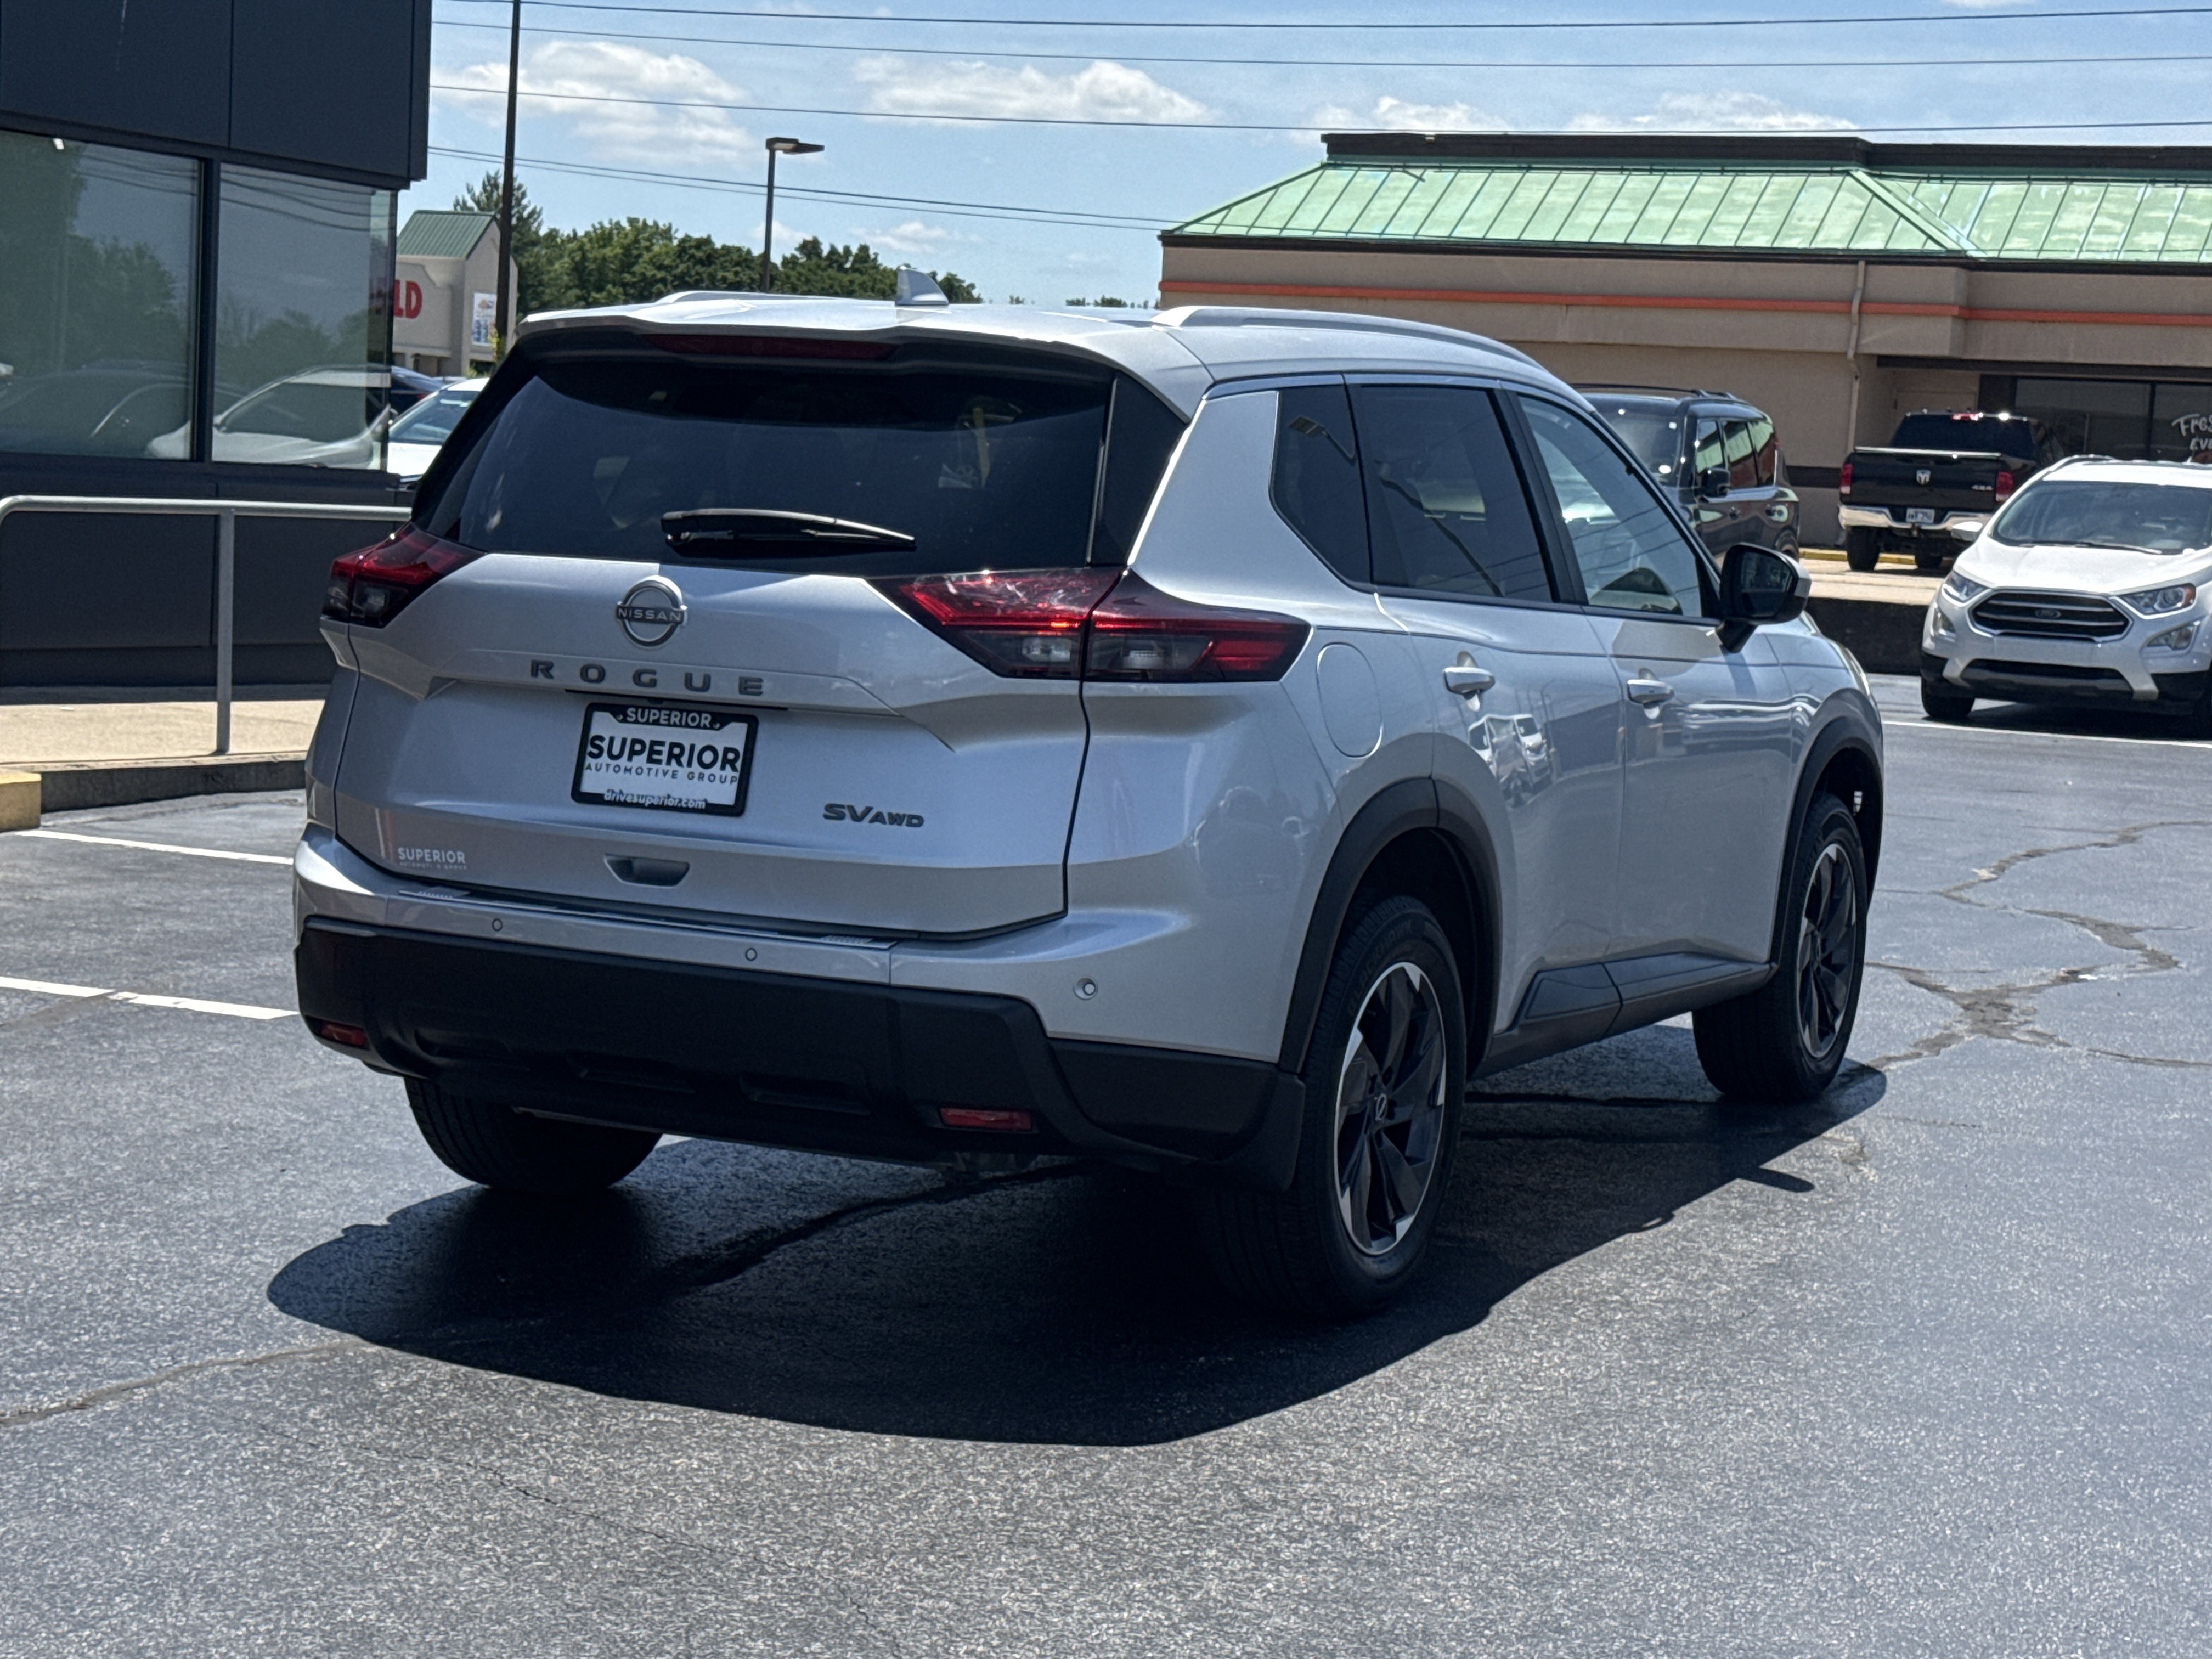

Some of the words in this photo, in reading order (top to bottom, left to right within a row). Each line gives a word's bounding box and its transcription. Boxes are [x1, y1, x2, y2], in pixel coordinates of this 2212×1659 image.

[618, 607, 681, 622] NISSAN
[530, 659, 764, 697] ROGUE
[626, 707, 712, 728] SUPERIOR
[586, 735, 741, 772] SUPERIOR
[585, 762, 679, 780] AUTOMOTIVE
[687, 771, 738, 785] GROUP
[603, 790, 706, 810] drivesuperior.com
[398, 847, 466, 864] SUPERIOR
